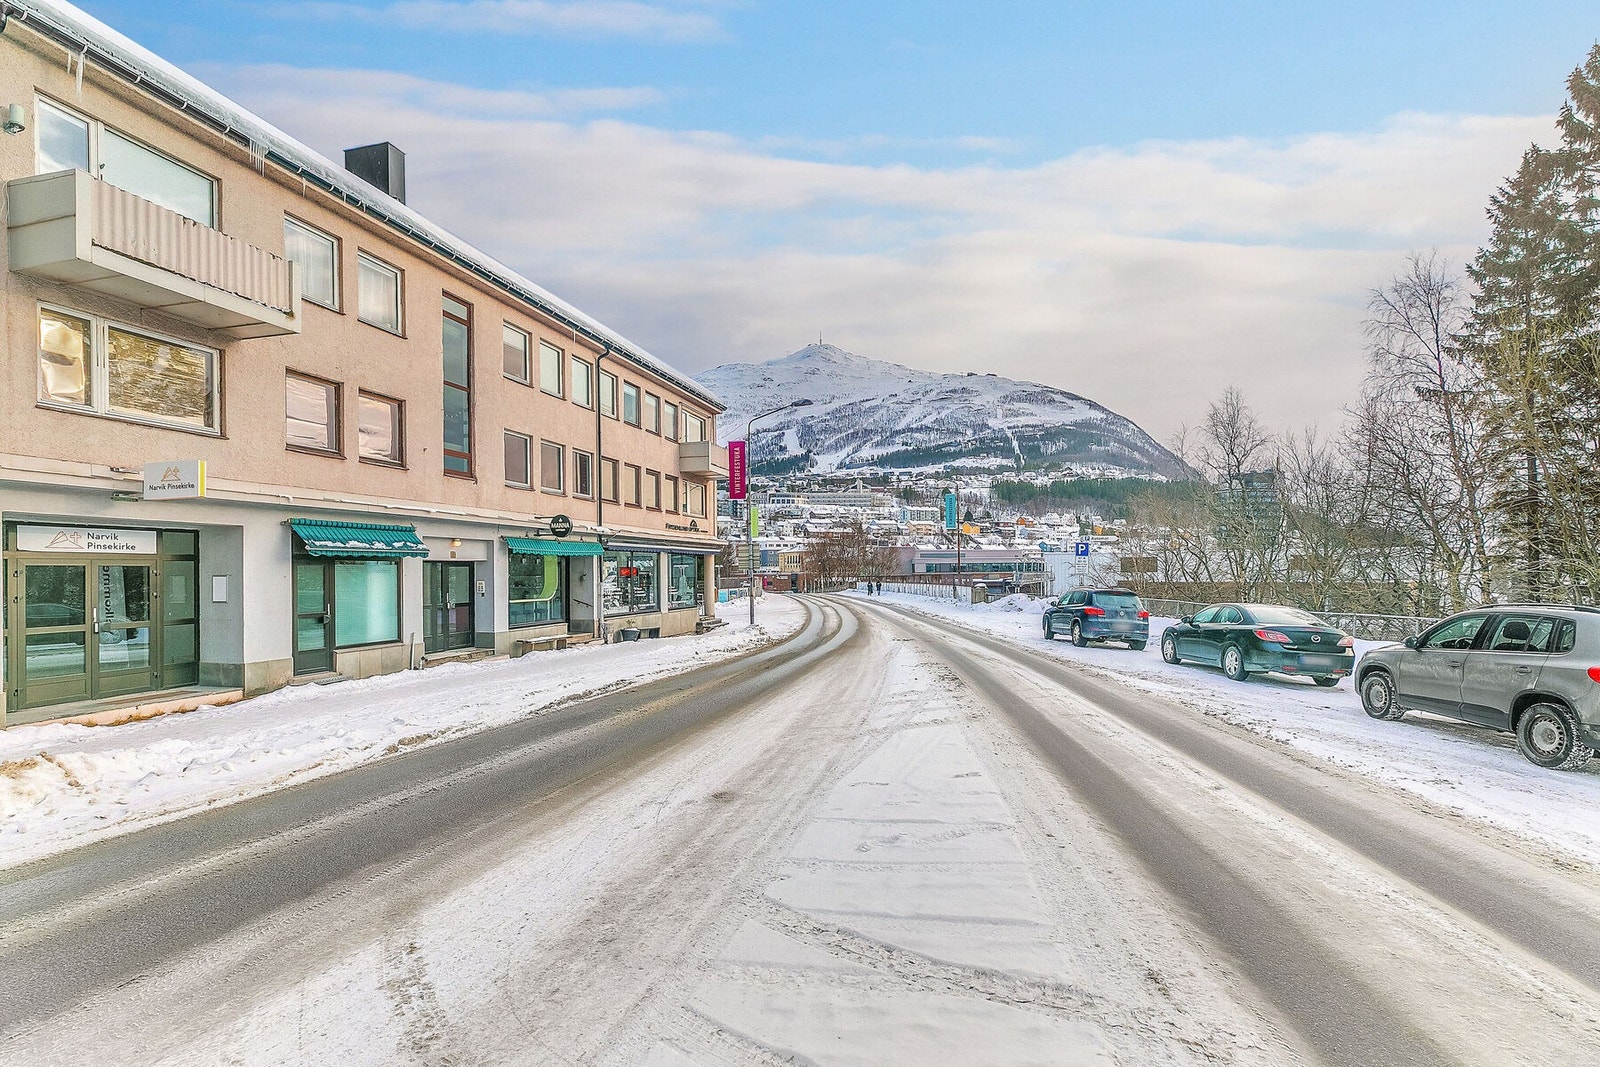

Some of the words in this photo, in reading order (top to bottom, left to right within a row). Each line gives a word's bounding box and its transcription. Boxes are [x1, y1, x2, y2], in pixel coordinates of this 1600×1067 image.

[733, 446, 741, 495] VINTERFESTUKA
[167, 482, 195, 490] Pinsekirke
[87, 532, 119, 541] Narvik
[87, 542, 136, 551] Pinsekirke
[1078, 544, 1086, 555] P
